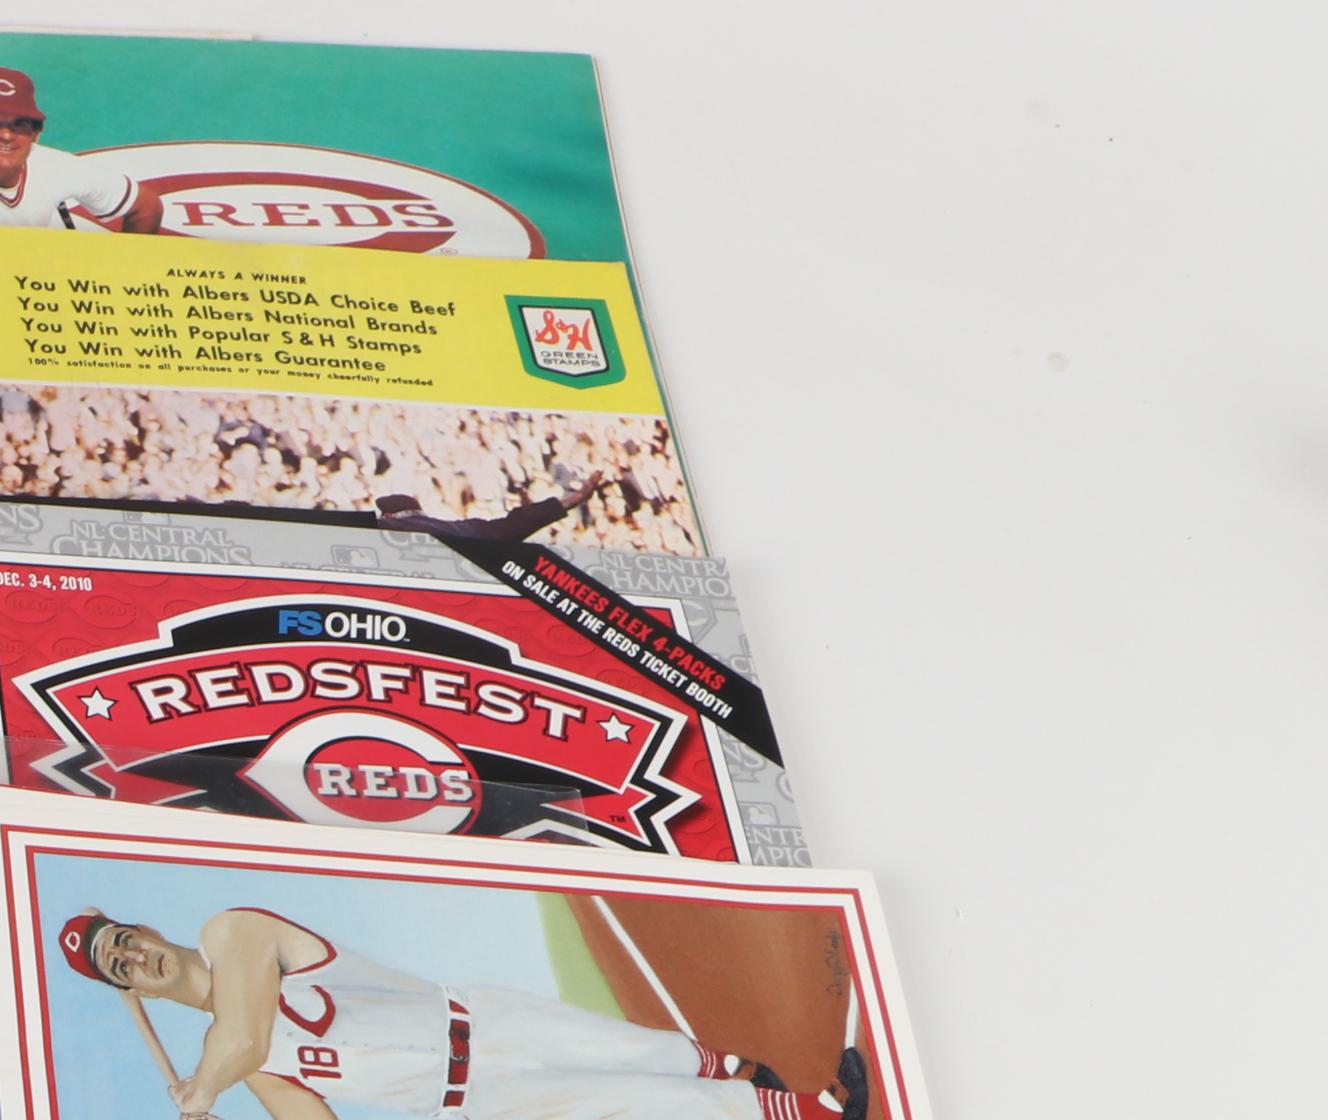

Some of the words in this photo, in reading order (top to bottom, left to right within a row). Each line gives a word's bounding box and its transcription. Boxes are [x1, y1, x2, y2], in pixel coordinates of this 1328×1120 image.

[172, 202, 454, 228] REDS
[167, 268, 226, 280] ALWAYS
[234, 272, 243, 280] A
[252, 272, 307, 285] WINNER
[14, 276, 56, 292] You
[67, 279, 111, 295] Win
[122, 283, 170, 298] with
[182, 285, 249, 302] Albers
[260, 288, 320, 307] USDA
[330, 294, 399, 312] Choice
[409, 299, 456, 317] Beef
[17, 296, 59, 313] You
[71, 300, 115, 316] Win
[126, 303, 174, 319] with
[186, 305, 254, 321] Albers
[263, 310, 356, 329] National
[367, 317, 438, 336] Brands
[20, 317, 63, 334] You
[74, 320, 119, 336] Win
[130, 324, 178, 339] with
[189, 325, 270, 343] Popular
[282, 330, 294, 345] S
[300, 332, 314, 346] &
[319, 333, 335, 348] H
[346, 335, 422, 356] Stamps
[24, 338, 67, 355] You
[78, 340, 123, 356] Win
[134, 345, 182, 359] with
[195, 346, 263, 362] Albers
[275, 350, 386, 372] Guarantee
[66, 359, 132, 369] satisfaction
[178, 364, 232, 374] purchases
[327, 372, 380, 384] cheerfully
[540, 351, 598, 359] GREEN
[543, 359, 600, 367] STAMPS
[29, 573, 57, 590] 3-4,
[61, 575, 93, 592] 2010
[324, 612, 407, 642] OHIO
[502, 560, 525, 581] ON
[523, 573, 561, 604] SALE
[556, 597, 579, 615] AT
[577, 608, 605, 634] THE
[602, 626, 641, 658] REDS
[639, 647, 688, 688] TICKET
[685, 681, 733, 719] BOOTH
[533, 556, 609, 614] YANKEES
[607, 606, 654, 640] FLEX
[652, 635, 726, 690] 4-PACKS
[135, 661, 585, 739] REDSFEST
[313, 763, 473, 802] REDS
[298, 1044, 342, 1080] 18
